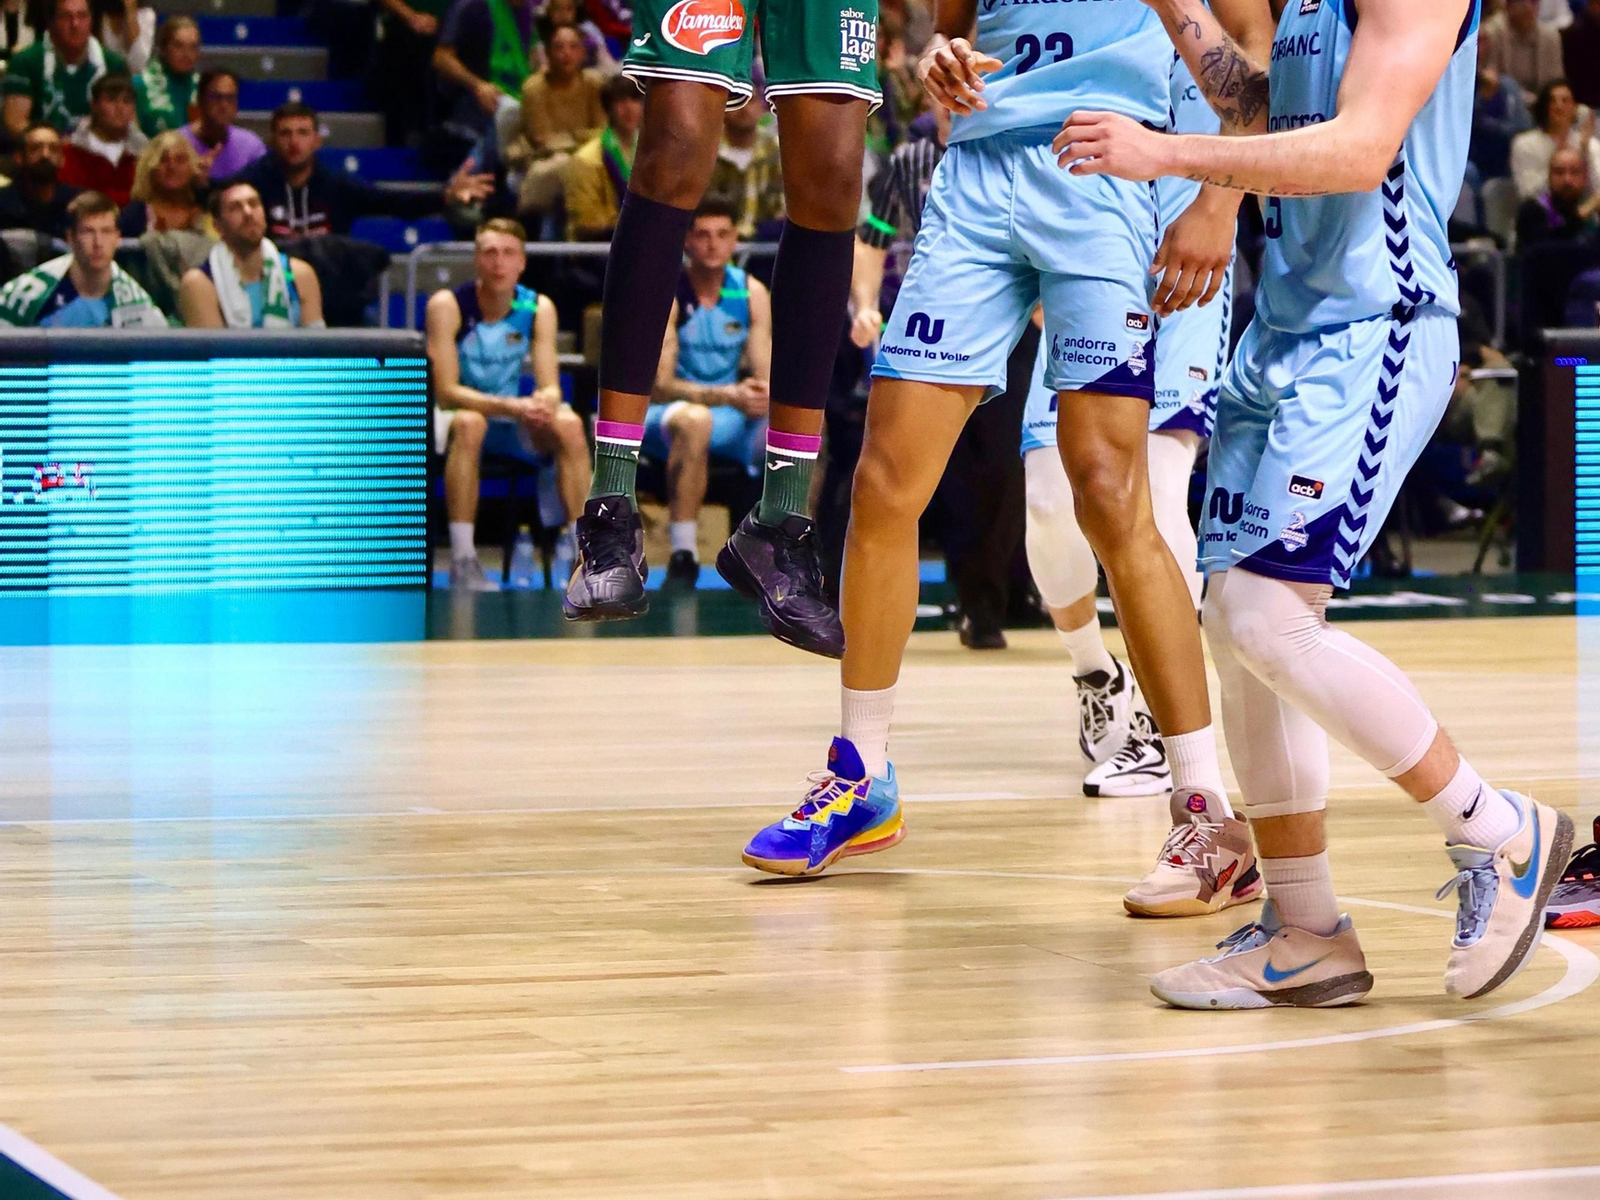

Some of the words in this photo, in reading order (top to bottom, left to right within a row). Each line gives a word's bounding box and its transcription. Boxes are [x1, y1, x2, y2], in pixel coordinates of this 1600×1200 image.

[840, 7, 864, 19] sabor
[1127, 318, 1143, 329] acb
[1063, 336, 1117, 352] andorra
[880, 344, 922, 358] Andorra
[924, 349, 937, 360] la
[1062, 350, 1118, 367] telecom
[1290, 483, 1316, 497] acb
